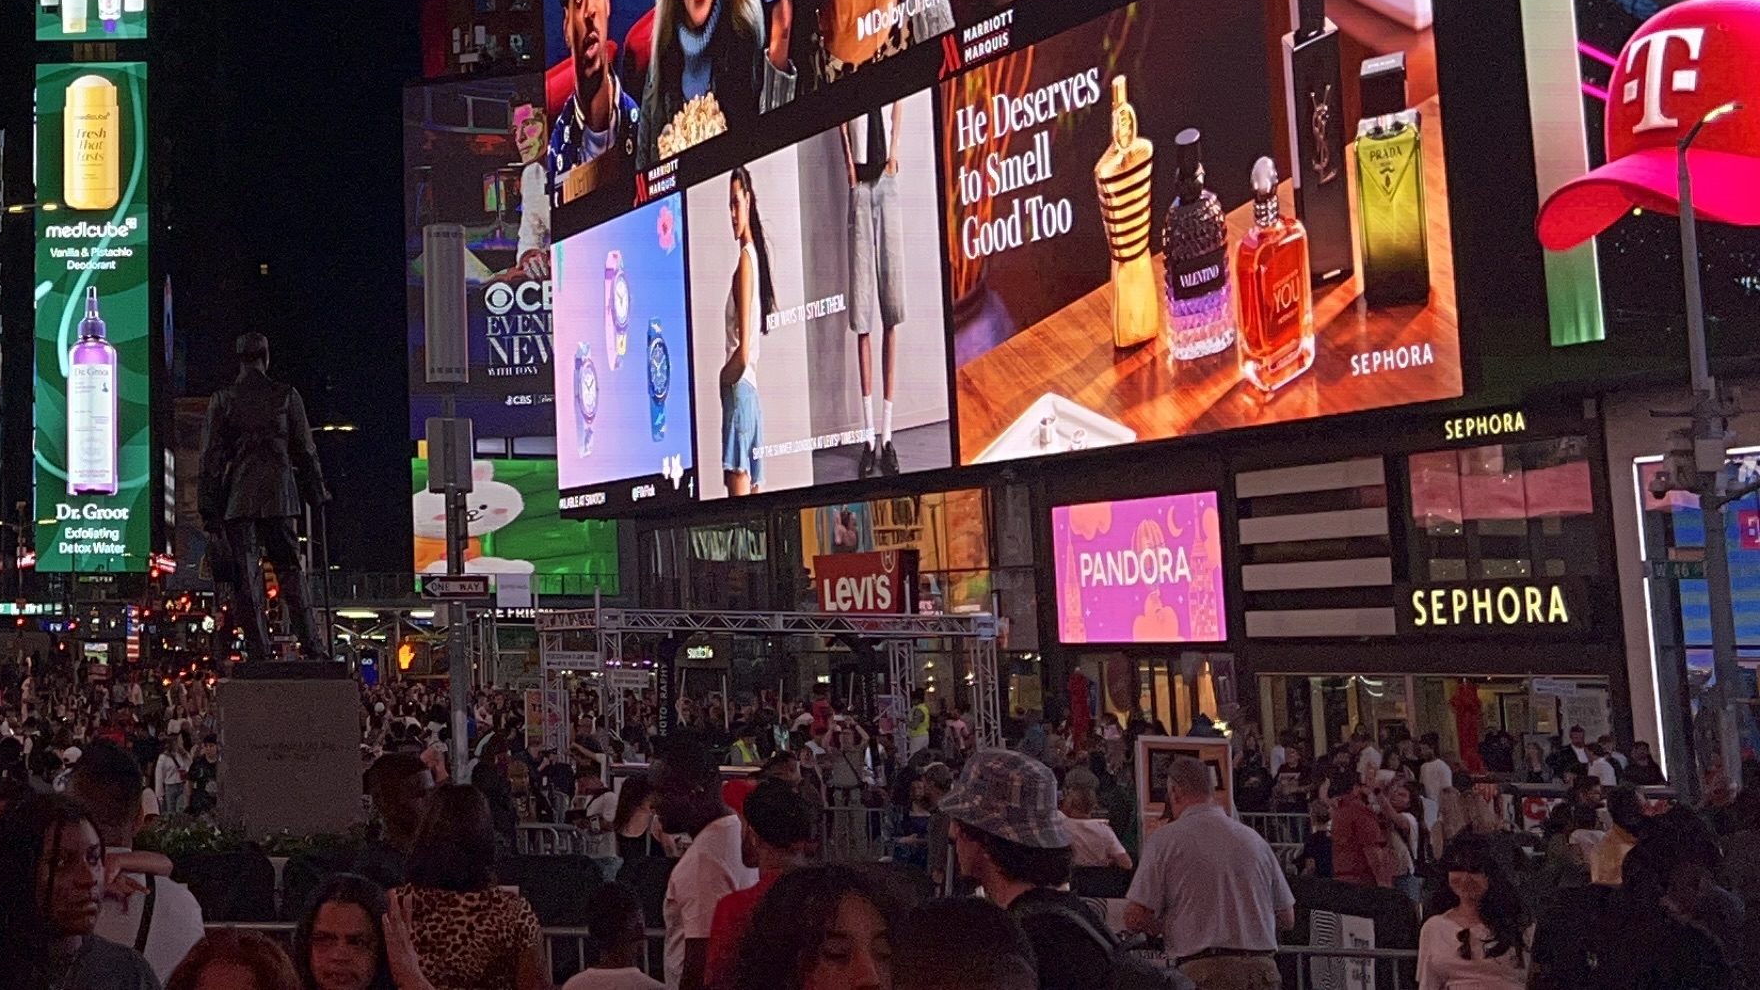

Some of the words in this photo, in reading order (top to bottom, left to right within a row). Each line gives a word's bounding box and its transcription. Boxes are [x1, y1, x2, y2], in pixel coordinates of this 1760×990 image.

[872, 0, 905, 34] Dolby
[963, 10, 1014, 43] MARRIOTT
[964, 32, 1009, 63] MARQUIS
[956, 104, 987, 152] He
[991, 66, 1101, 139] Deserves
[1369, 146, 1403, 161] PRADA
[648, 158, 679, 181] MARRIOTT
[958, 165, 982, 206] to
[987, 130, 1053, 197] Smell
[649, 176, 676, 195] MARQUIS
[962, 200, 1023, 260] Good
[1025, 196, 1074, 243] Too
[82, 248, 89, 257] &
[91, 247, 133, 257] Pistachio
[67, 261, 116, 270] Deodorant
[1179, 264, 1220, 289] VALENTINO
[1273, 280, 1301, 314] YOU
[806, 299, 825, 321] STYLE
[1351, 343, 1435, 376] SEPHORA
[512, 395, 532, 405] CBS
[1445, 412, 1525, 441] SEPHORA
[56, 504, 81, 520] Dr.
[83, 504, 129, 520] Groot
[65, 528, 119, 541] Exfoliating
[59, 542, 91, 554] Detox
[93, 542, 126, 555] Water
[1080, 547, 1191, 587] PANDORA
[459, 582, 480, 593] WAY
[1413, 585, 1569, 626] SEPHORA
